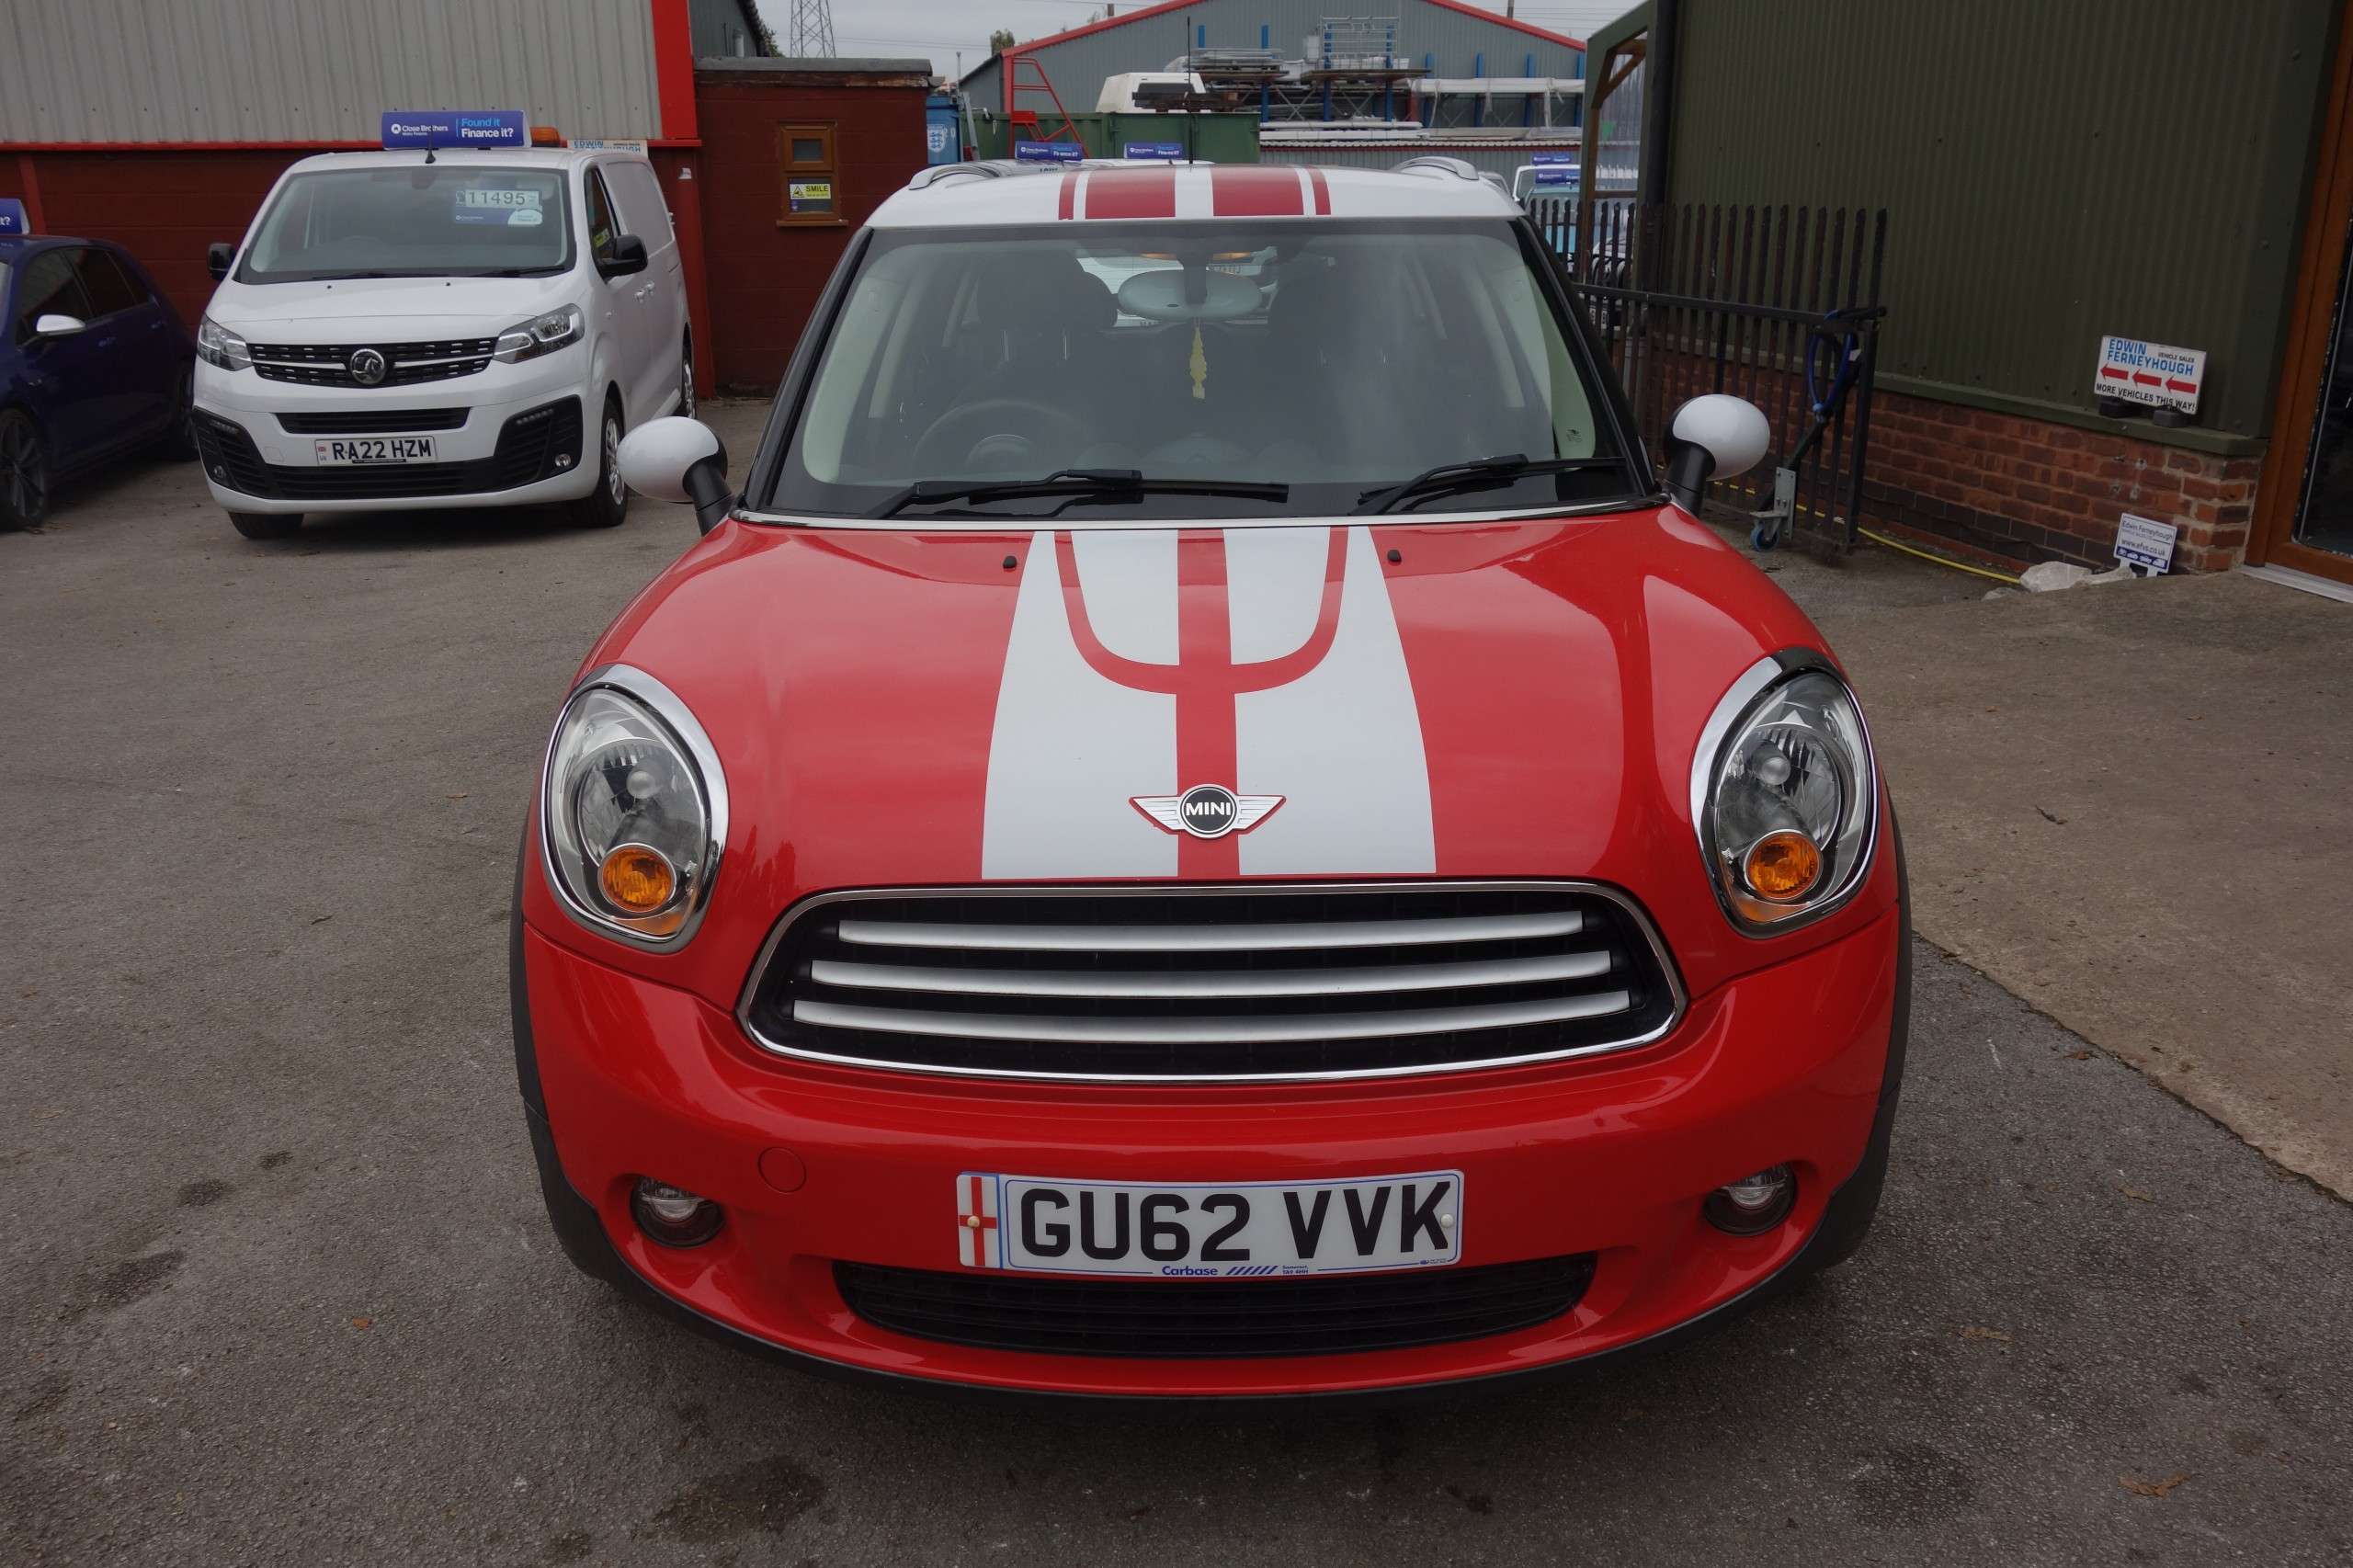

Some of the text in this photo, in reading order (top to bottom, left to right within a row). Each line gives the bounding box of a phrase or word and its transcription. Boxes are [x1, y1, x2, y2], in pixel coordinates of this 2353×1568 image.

[461, 118, 500, 127] Found it
[461, 127, 514, 138] Finance it?
[469, 191, 526, 205] 11495
[2109, 338, 2147, 357] EDWIN
[2107, 350, 2194, 376] FERNEYHOUGH
[2157, 351, 2195, 364] VEHICLE SALES
[2096, 383, 2197, 413] MORE VEHICLES THIS WAY!
[332, 439, 432, 460] RA22 HZM
[1186, 801, 1232, 816] MINI
[1020, 1180, 1452, 1262] GU62 VVK
[1162, 1265, 1218, 1276] Carbase
